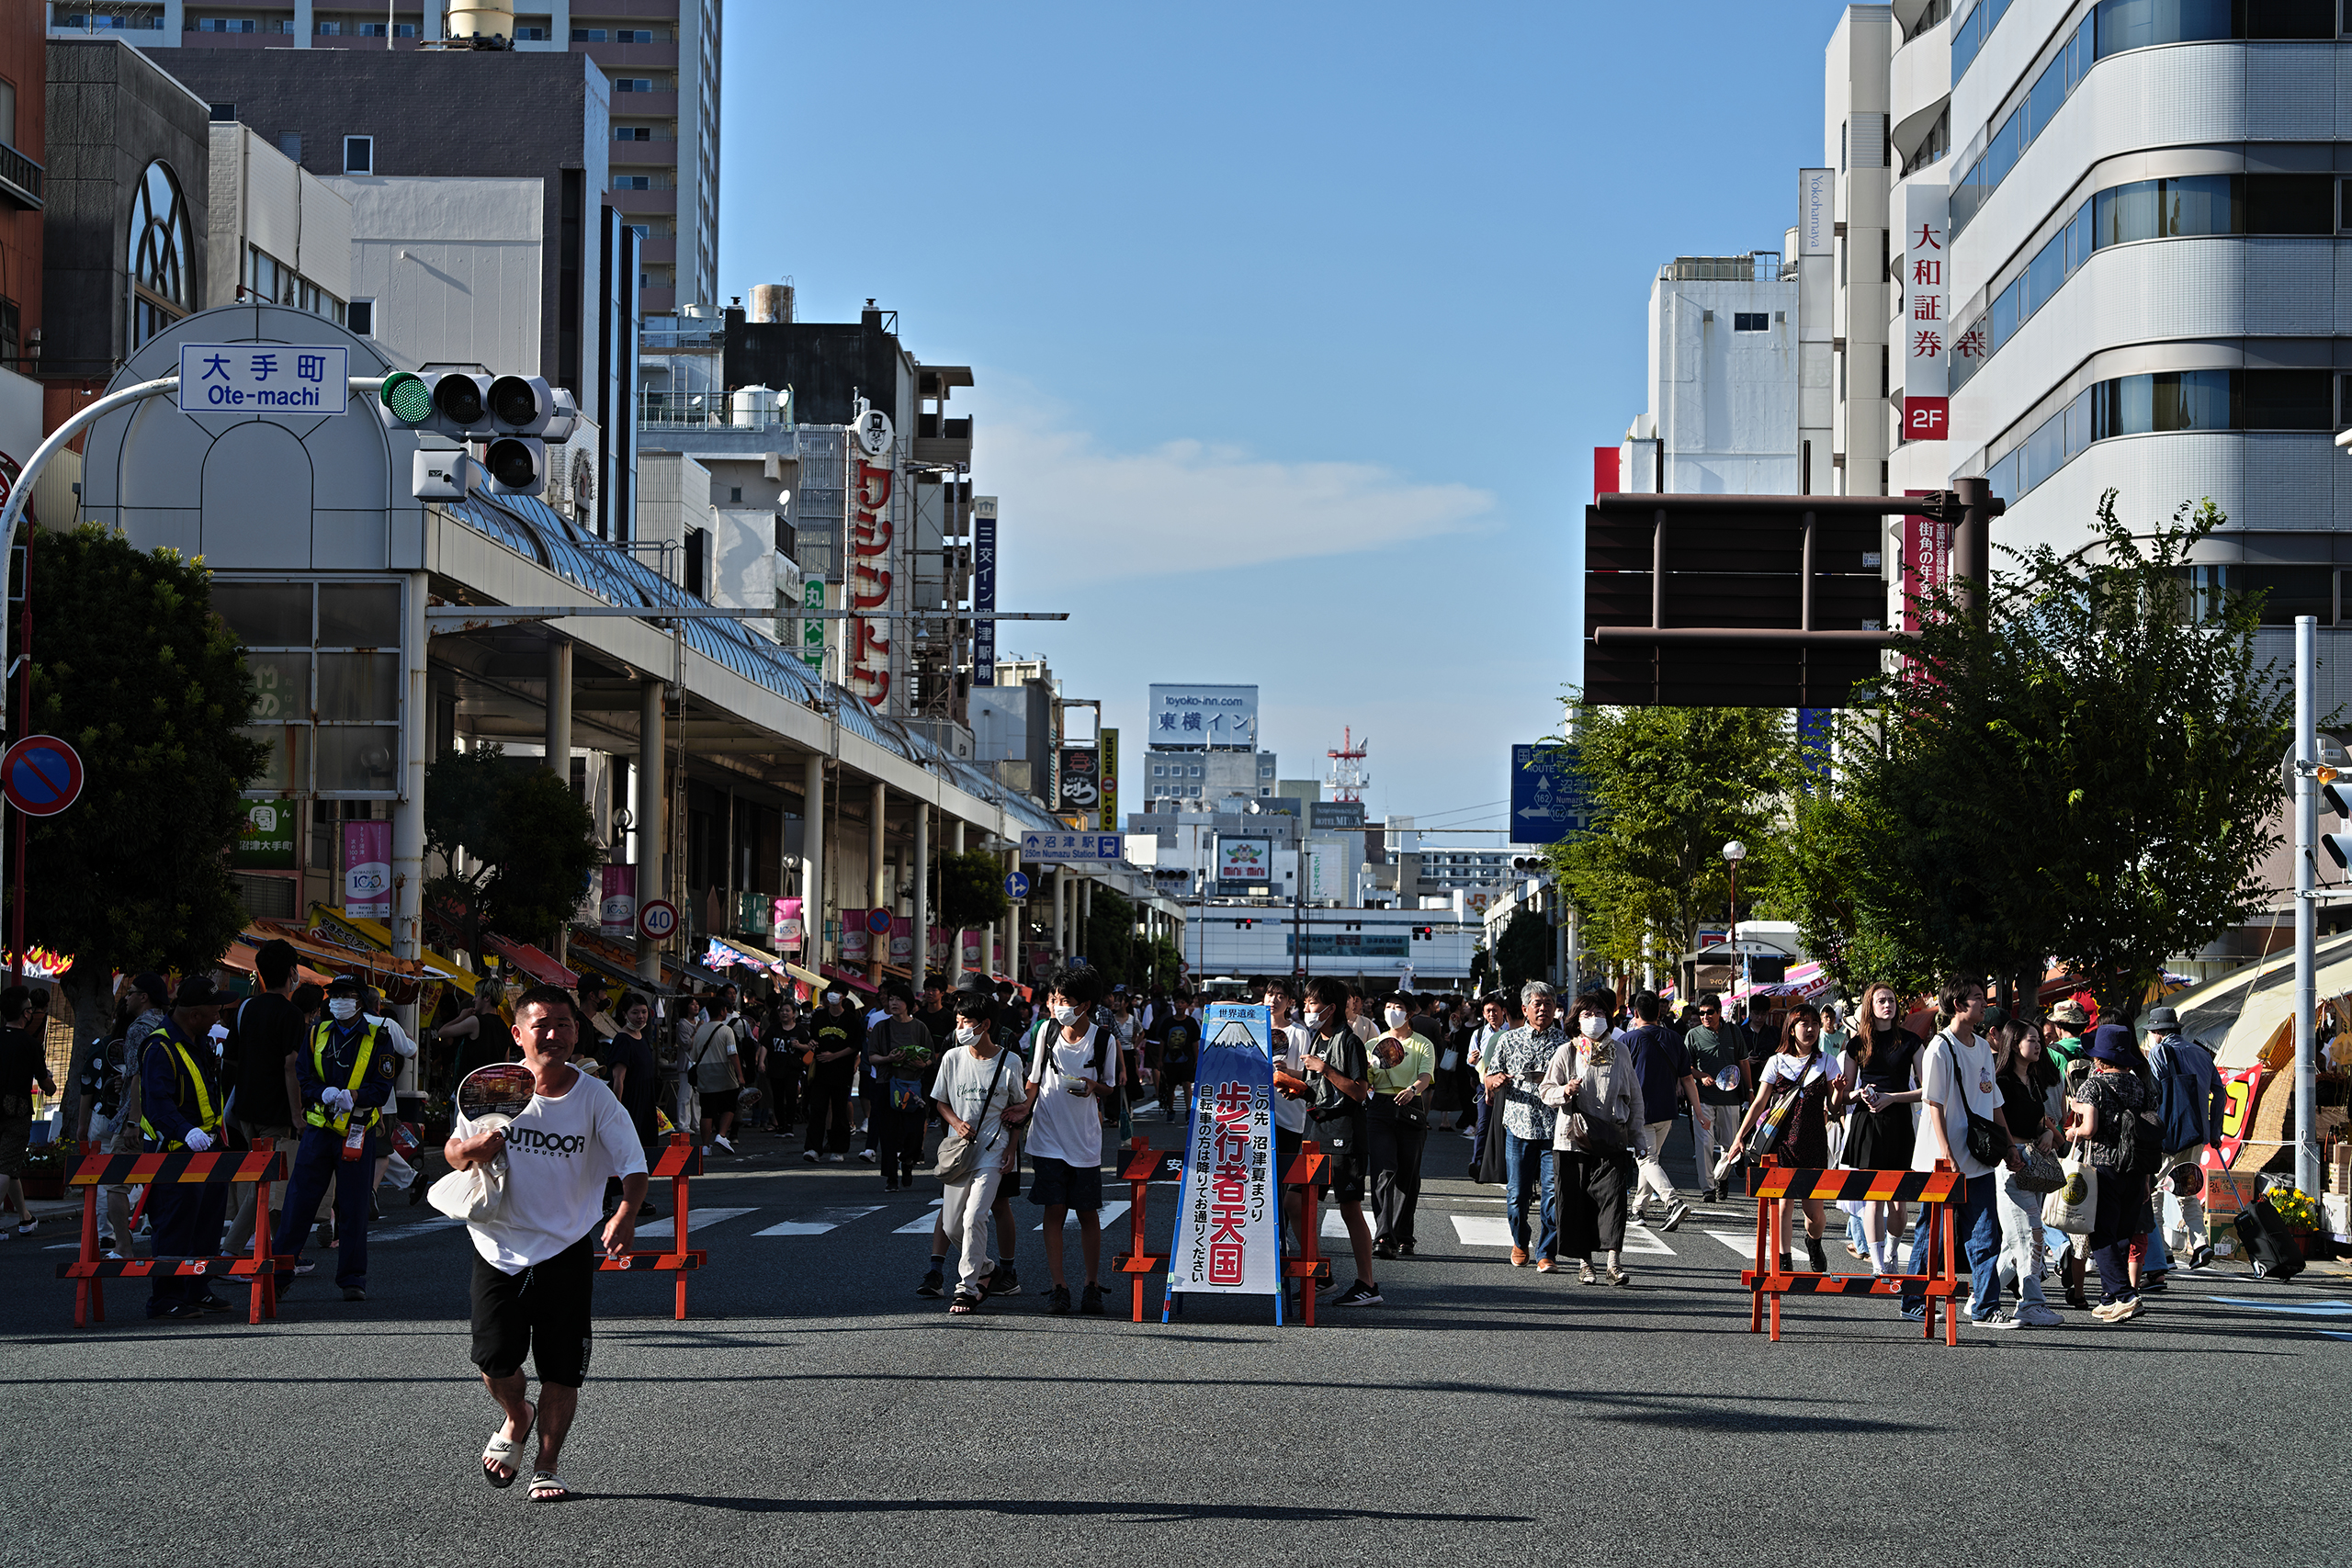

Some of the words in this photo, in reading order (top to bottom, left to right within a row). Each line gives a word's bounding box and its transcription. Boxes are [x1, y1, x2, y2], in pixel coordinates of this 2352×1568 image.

[1807, 175, 1824, 248] Yokohamaya
[1912, 223, 1942, 358] 大和証券
[201, 353, 326, 383] 大手町
[208, 384, 320, 406] Ote-machi
[1912, 409, 1942, 429] 2F
[1165, 695, 1243, 707] toyoko-inn.com
[1157, 711, 1250, 731] 東横イン
[1105, 737, 1114, 774] MIXER
[1526, 764, 1555, 773] ROUTE
[1536, 794, 1550, 803] 162
[1315, 818, 1335, 826] HOTEL
[1336, 816, 1362, 826] MIWA
[239, 840, 293, 852] 沼津大手町
[1044, 836, 1095, 848] 沼津駅
[1024, 849, 1041, 858] 250m
[1042, 849, 1070, 858] Numazu
[1072, 849, 1096, 858] Station
[1465, 894, 1487, 906] JR
[648, 911, 670, 929] 40
[1218, 1008, 1257, 1020] 世界遺産
[1253, 1084, 1270, 1127] この先
[509, 1145, 571, 1159] PRODUCTS
[1191, 1084, 1214, 1283] 自転車の方は降りてお通りください
[1208, 1080, 1252, 1287] 歩行者天国
[1250, 1135, 1269, 1224] 沼津夏まつり
